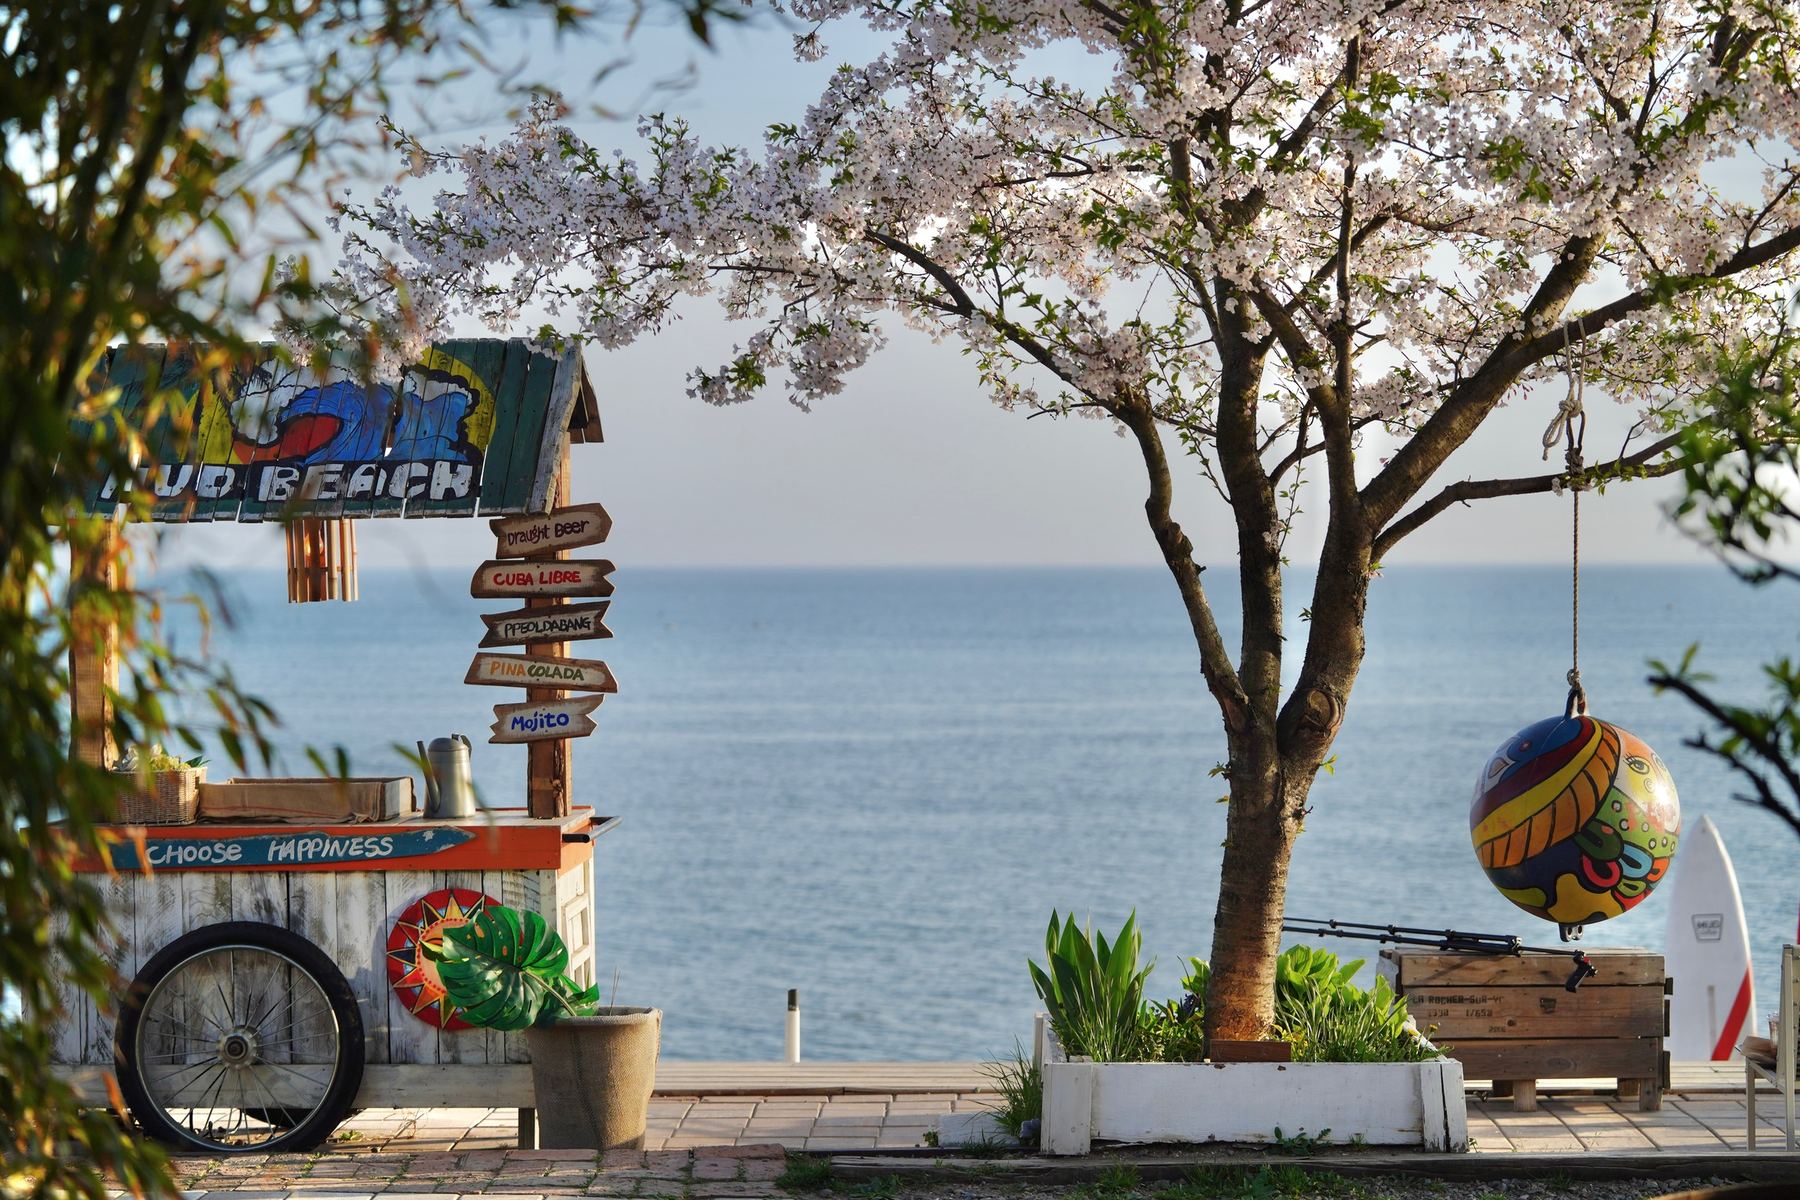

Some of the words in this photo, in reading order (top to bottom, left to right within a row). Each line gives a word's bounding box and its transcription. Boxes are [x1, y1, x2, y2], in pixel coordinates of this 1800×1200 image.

[258, 461, 473, 501] BEACH
[554, 520, 590, 538] Beer
[493, 571, 534, 586] CUBA
[539, 570, 582, 585] LIBRE
[504, 616, 592, 638] PPEOLDABANG
[511, 711, 570, 732] Mojito
[267, 837, 394, 862] HAPPINESS
